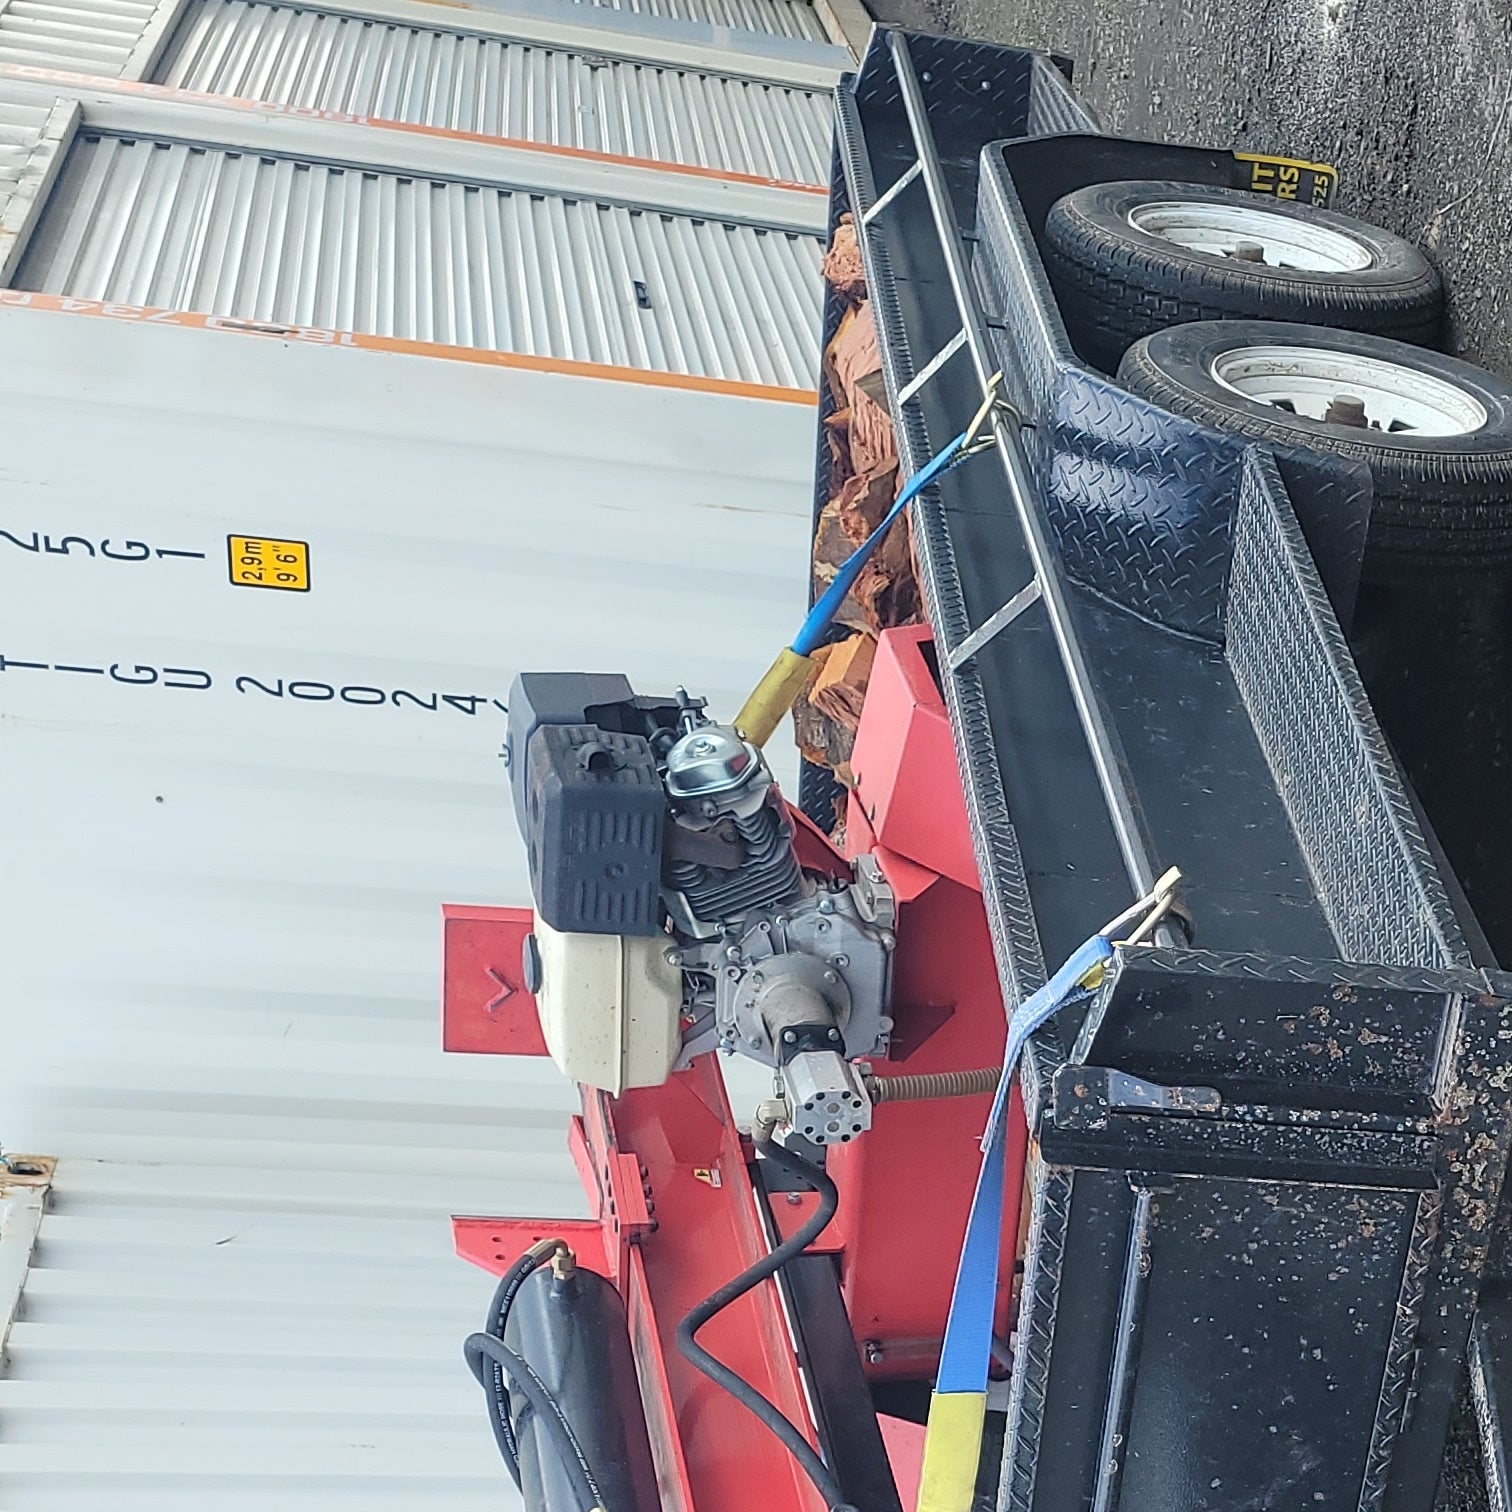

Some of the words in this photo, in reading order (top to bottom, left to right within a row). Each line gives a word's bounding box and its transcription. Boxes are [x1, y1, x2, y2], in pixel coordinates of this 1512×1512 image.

[60, 299, 181, 324] 734
[0, 530, 205, 561] 25G1
[0, 655, 212, 690] TIGU
[235, 676, 508, 715] 20024
